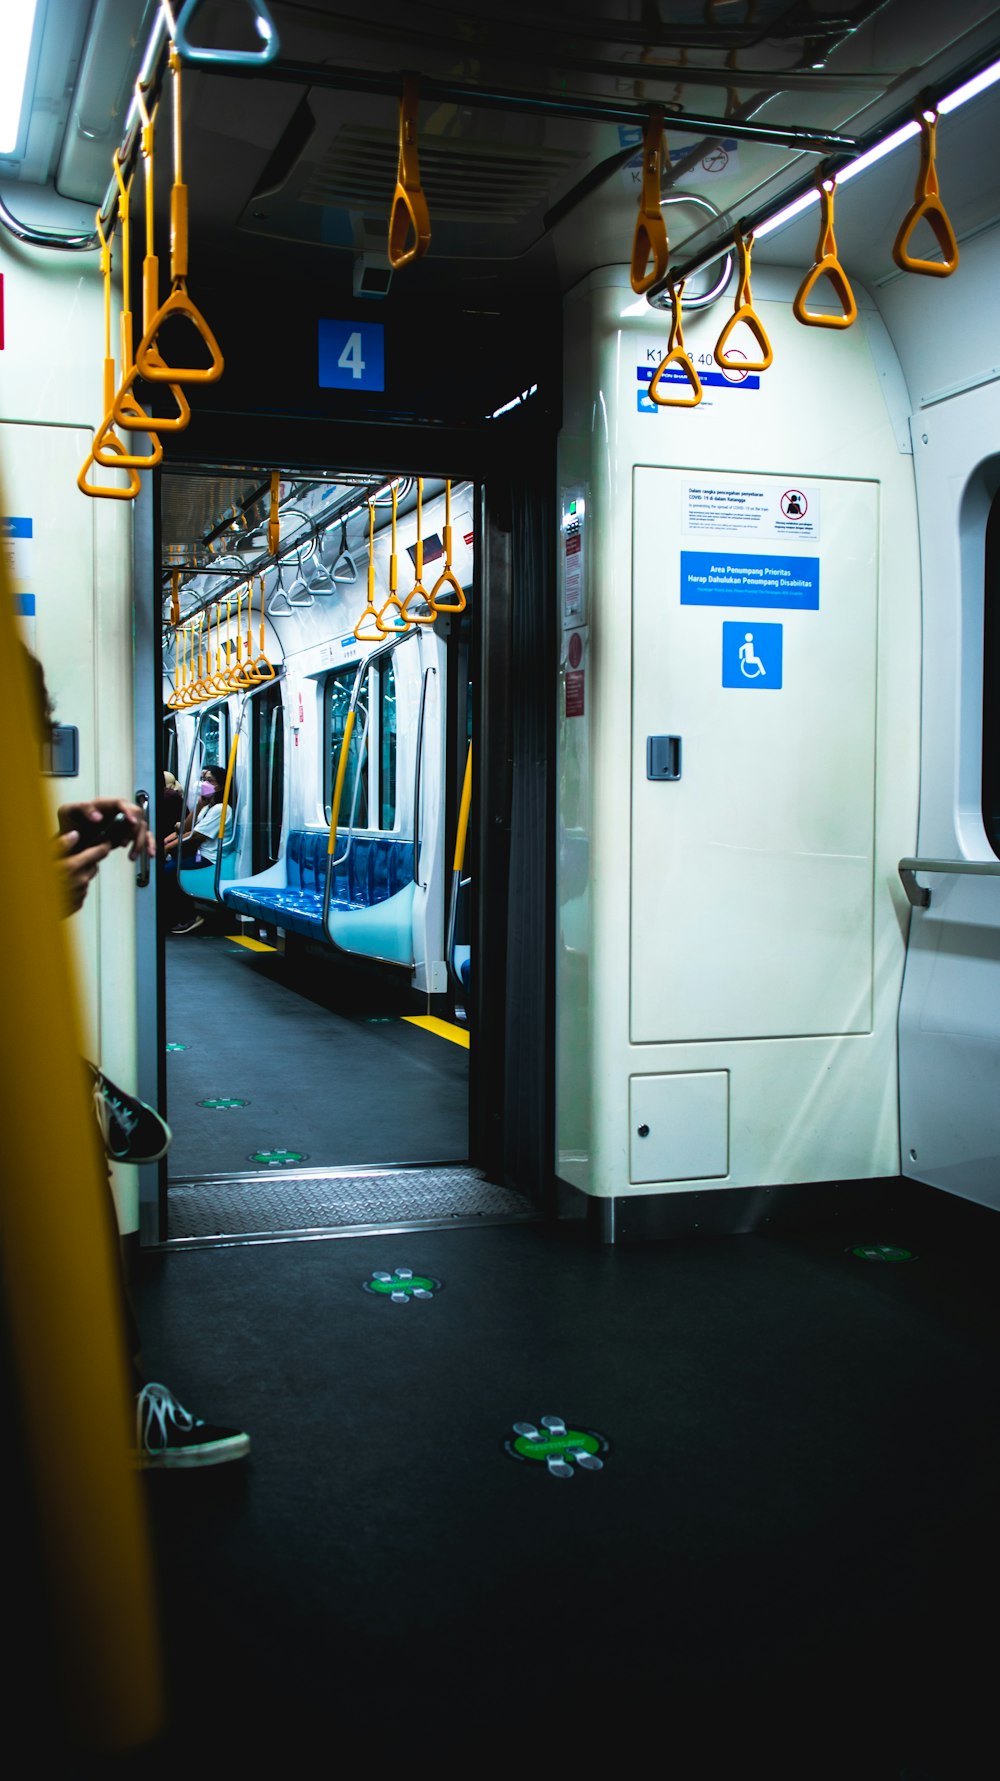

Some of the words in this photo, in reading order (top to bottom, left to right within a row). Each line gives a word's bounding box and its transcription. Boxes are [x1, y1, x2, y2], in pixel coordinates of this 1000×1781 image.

[338, 332, 366, 379] 4
[698, 353, 713, 366] 40
[727, 566, 763, 576] Penumpang
[765, 568, 791, 576] Prioritas
[688, 575, 707, 584] Harap
[708, 576, 741, 584] Dahulukan
[743, 577, 779, 587] Penumpang
[780, 579, 812, 587] Disabilitas
